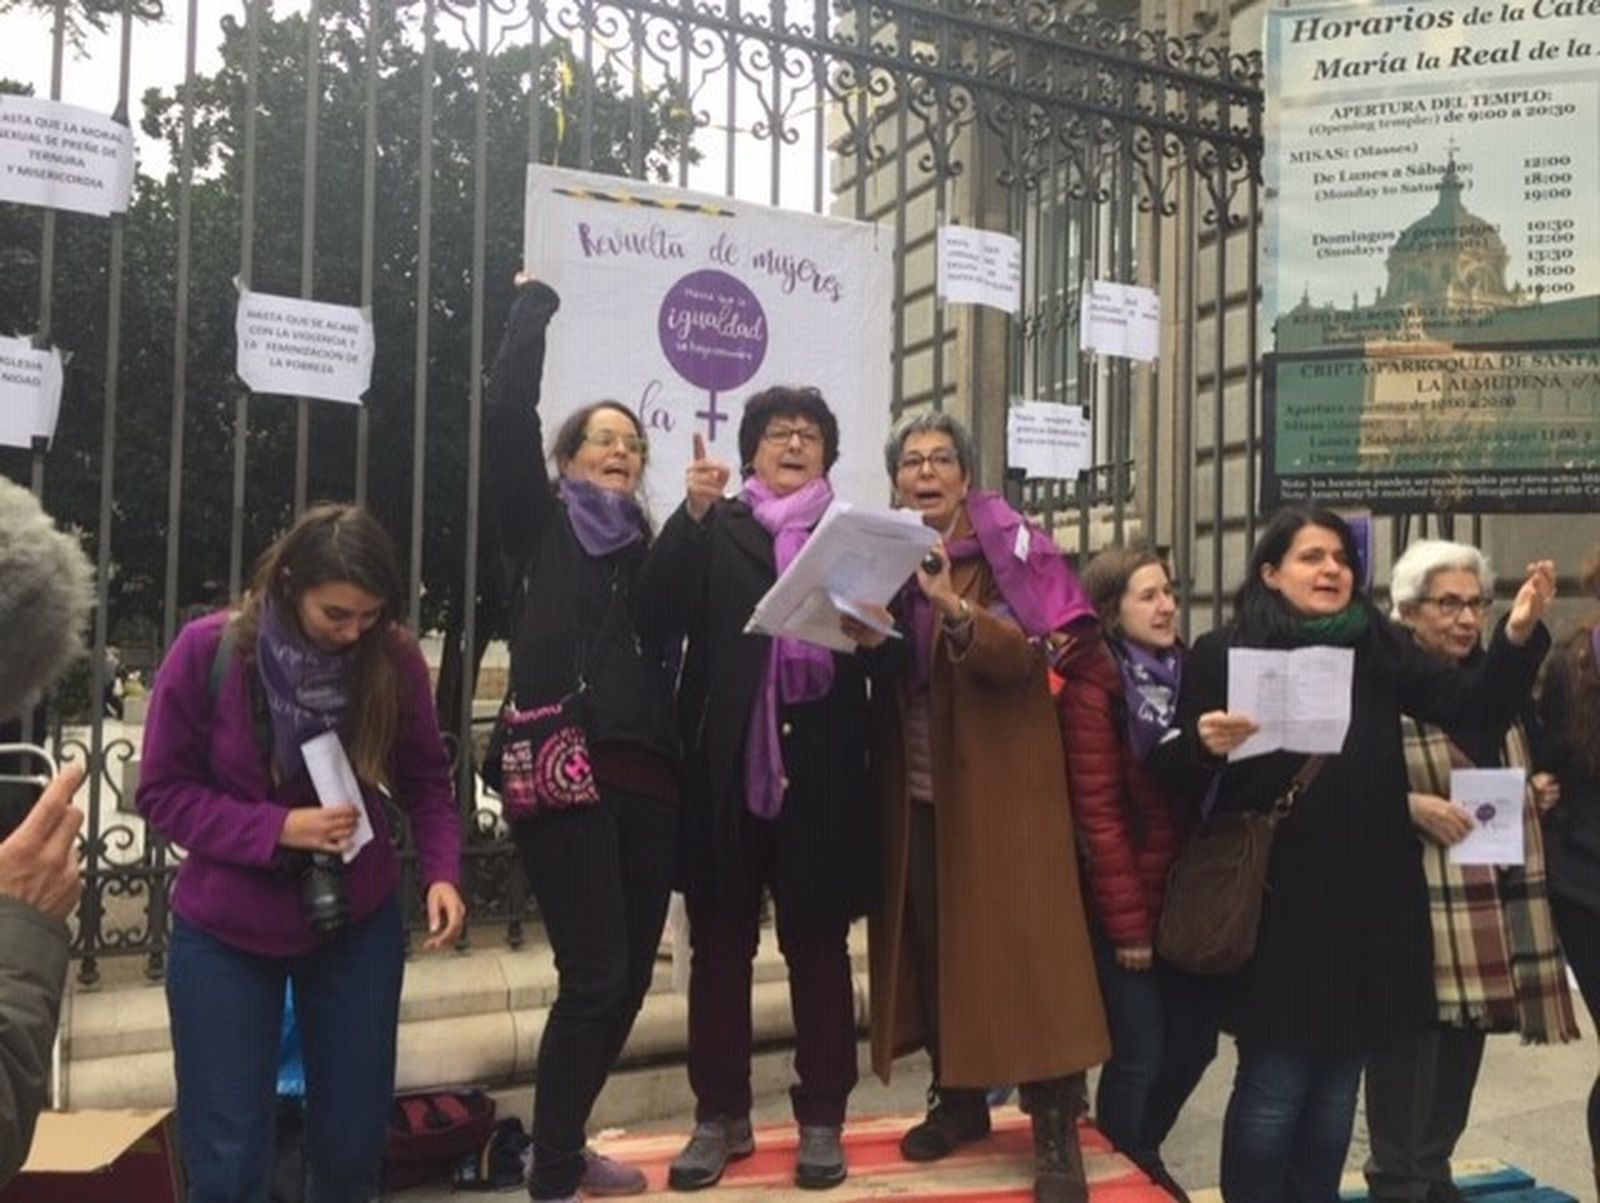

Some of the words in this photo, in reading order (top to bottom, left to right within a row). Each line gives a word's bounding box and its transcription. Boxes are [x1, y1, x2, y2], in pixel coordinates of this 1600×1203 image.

[1291, 6, 1454, 43] Horarios
[1463, 6, 1493, 26] de
[1501, 4, 1524, 22] la
[1313, 51, 1406, 81] María
[1416, 52, 1440, 70] la
[1450, 40, 1520, 68] Real
[1529, 41, 1559, 61] de
[1567, 38, 1591, 58] la
[1330, 99, 1427, 120] APERTURA
[1431, 96, 1467, 111] DEL
[1471, 90, 1552, 107] TEMPLO:
[1309, 119, 1375, 136] (Opening
[1444, 110, 1464, 123] de
[1468, 108, 1507, 123] 9:00
[1511, 107, 1521, 118] a
[1526, 102, 1576, 117] 20:30
[34, 116, 61, 132] QUE
[64, 122, 79, 134] LA
[81, 125, 123, 145] MORAL
[44, 134, 60, 147] SE
[102, 147, 118, 159] DE
[1289, 149, 1350, 163] MISAS:
[1353, 141, 1418, 159] (Masses)
[28, 149, 86, 168] TERNURA
[1524, 155, 1571, 168] 12:00
[17, 165, 104, 189] MISERICORDIA
[1314, 172, 1336, 185] De
[1340, 167, 1388, 183] Lunes
[1392, 167, 1403, 179] a
[1524, 171, 1572, 185] 18:00
[1315, 187, 1378, 202] (Monday
[1382, 184, 1398, 195] to
[1524, 187, 1571, 201] 19:00
[1527, 219, 1574, 232] 10:30
[1312, 230, 1396, 247] Domingos
[1527, 232, 1574, 245] 12:00
[1317, 244, 1384, 260] (Sundays
[1527, 247, 1573, 262] 13:30
[578, 222, 684, 260] Revuelta
[708, 232, 740, 266] de
[752, 249, 843, 303] mujeres
[1527, 263, 1575, 278] 18:00
[247, 309, 283, 323] HASTA
[667, 305, 763, 342] igualdad
[244, 339, 258, 351] LA
[249, 323, 274, 338] CON
[276, 328, 291, 340] LA
[292, 330, 348, 349] VIOLENCIA
[269, 357, 283, 369] LA
[286, 359, 335, 375] POBREZA
[1500, 355, 1522, 370] DE
[1532, 351, 1600, 368] SANTA
[1416, 377, 1441, 394] LA
[1448, 373, 1562, 392] ALMUDENA
[639, 378, 676, 433] la
